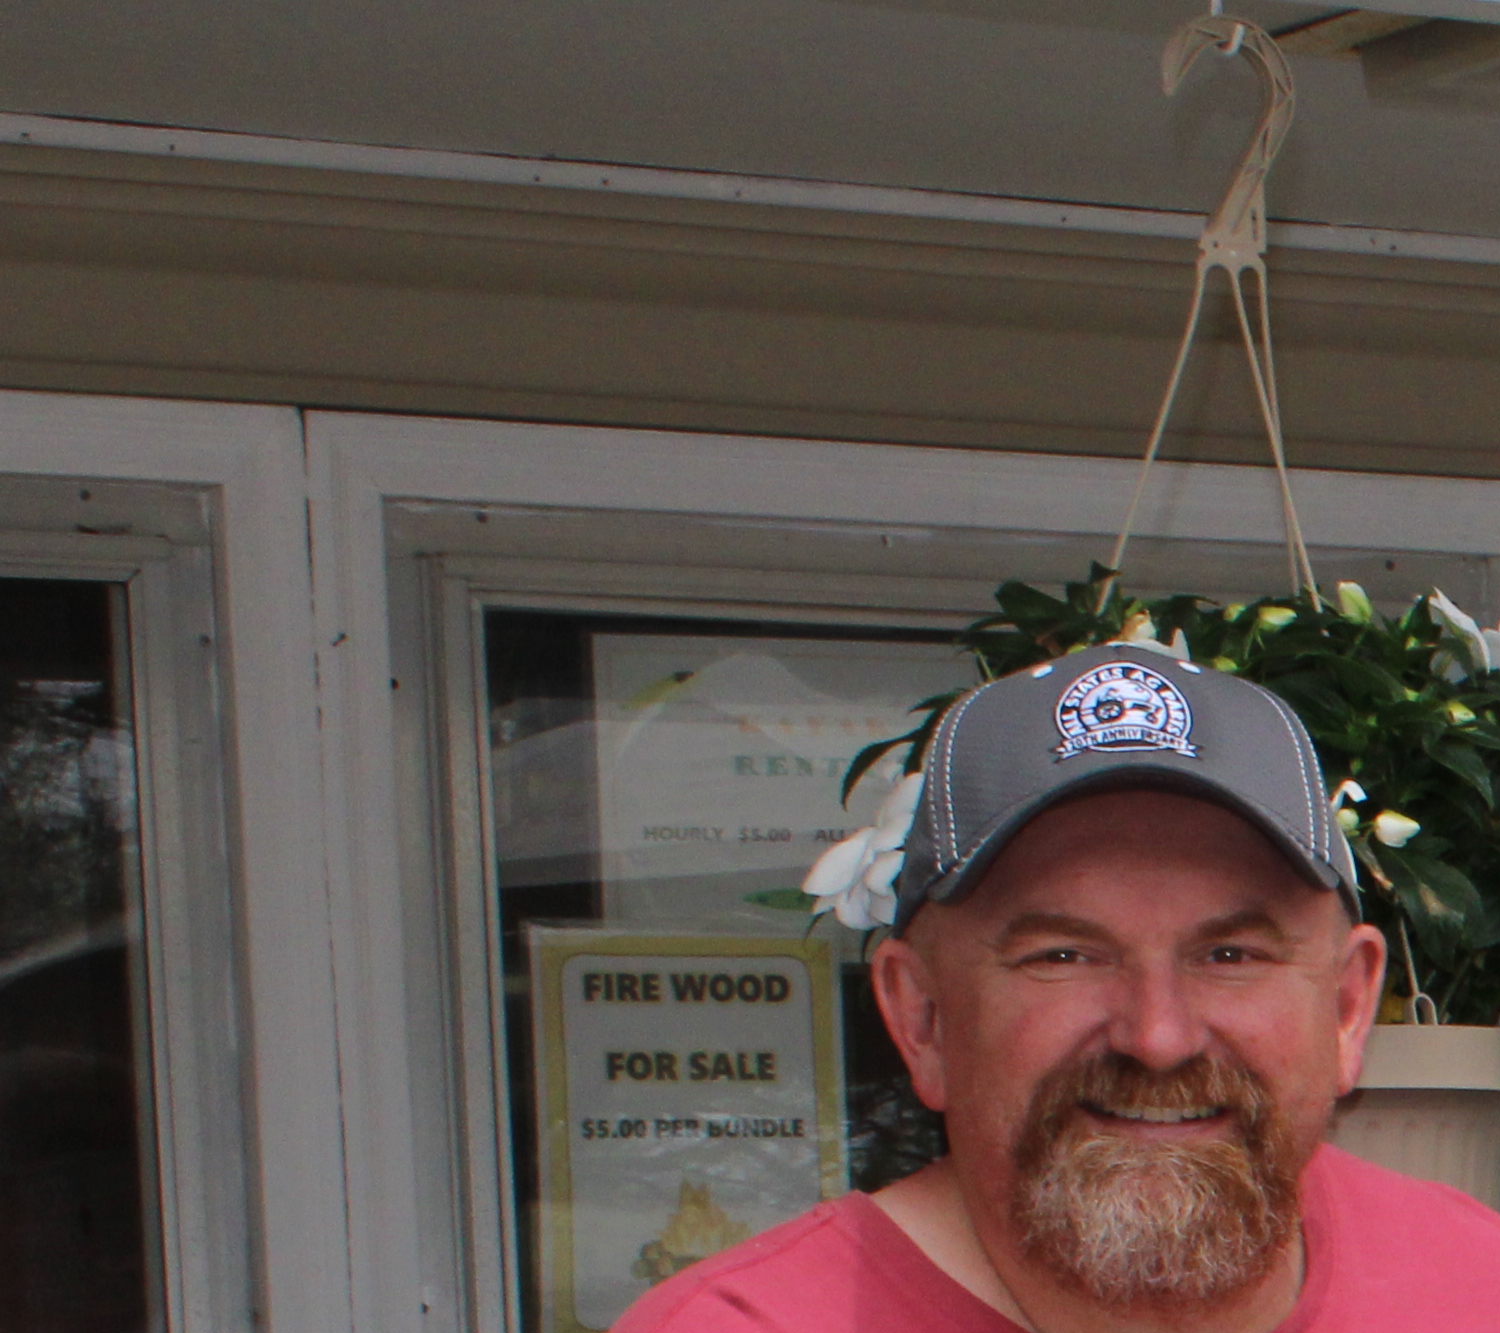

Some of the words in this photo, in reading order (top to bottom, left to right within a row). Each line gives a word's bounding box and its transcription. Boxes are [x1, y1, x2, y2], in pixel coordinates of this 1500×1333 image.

[1064, 667, 1124, 708] STATES
[1130, 670, 1162, 690] AG
[1160, 688, 1185, 736] PARTS
[582, 972, 662, 1002] FIRE
[669, 973, 790, 1003] WOOD
[605, 1051, 678, 1080] FOR
[688, 1051, 776, 1080] SALE
[581, 1117, 647, 1140] $5.00
[653, 1118, 700, 1138] PER
[706, 1118, 806, 1139] BUNDLE
